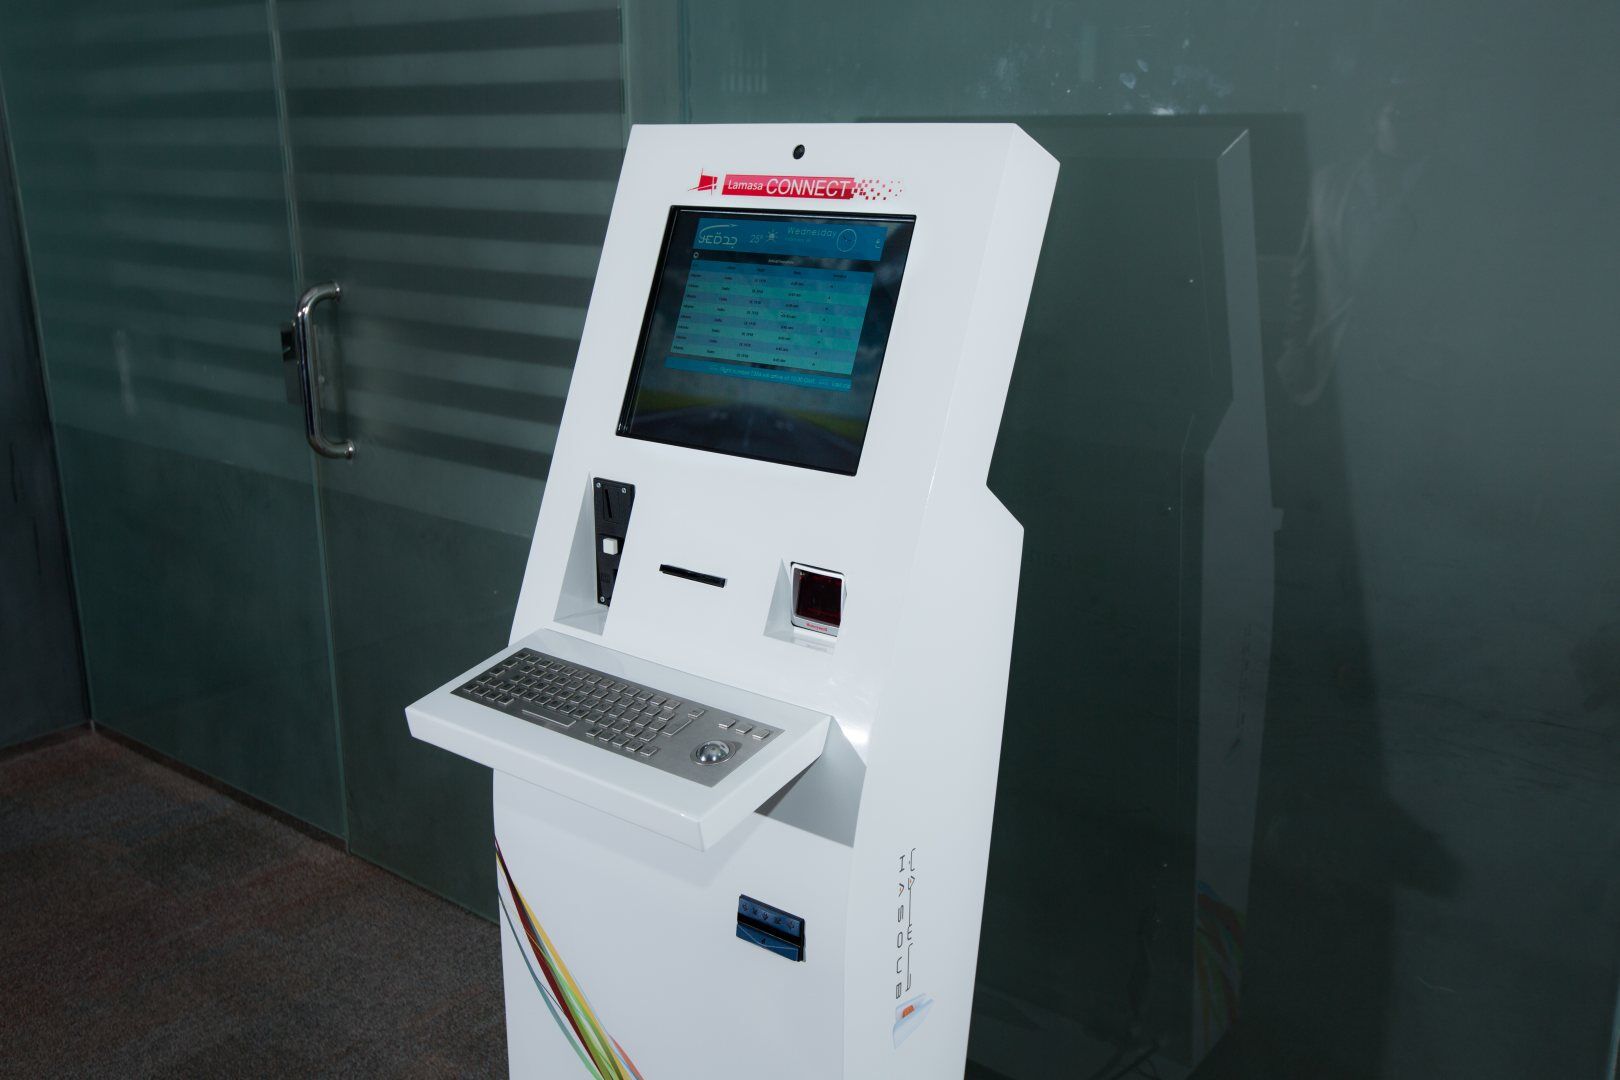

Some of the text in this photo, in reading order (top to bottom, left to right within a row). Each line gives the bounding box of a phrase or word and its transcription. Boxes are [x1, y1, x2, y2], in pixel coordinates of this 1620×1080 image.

[728, 178, 851, 197] Lamasa CONNECT
[895, 854, 906, 1000] HASOUB
